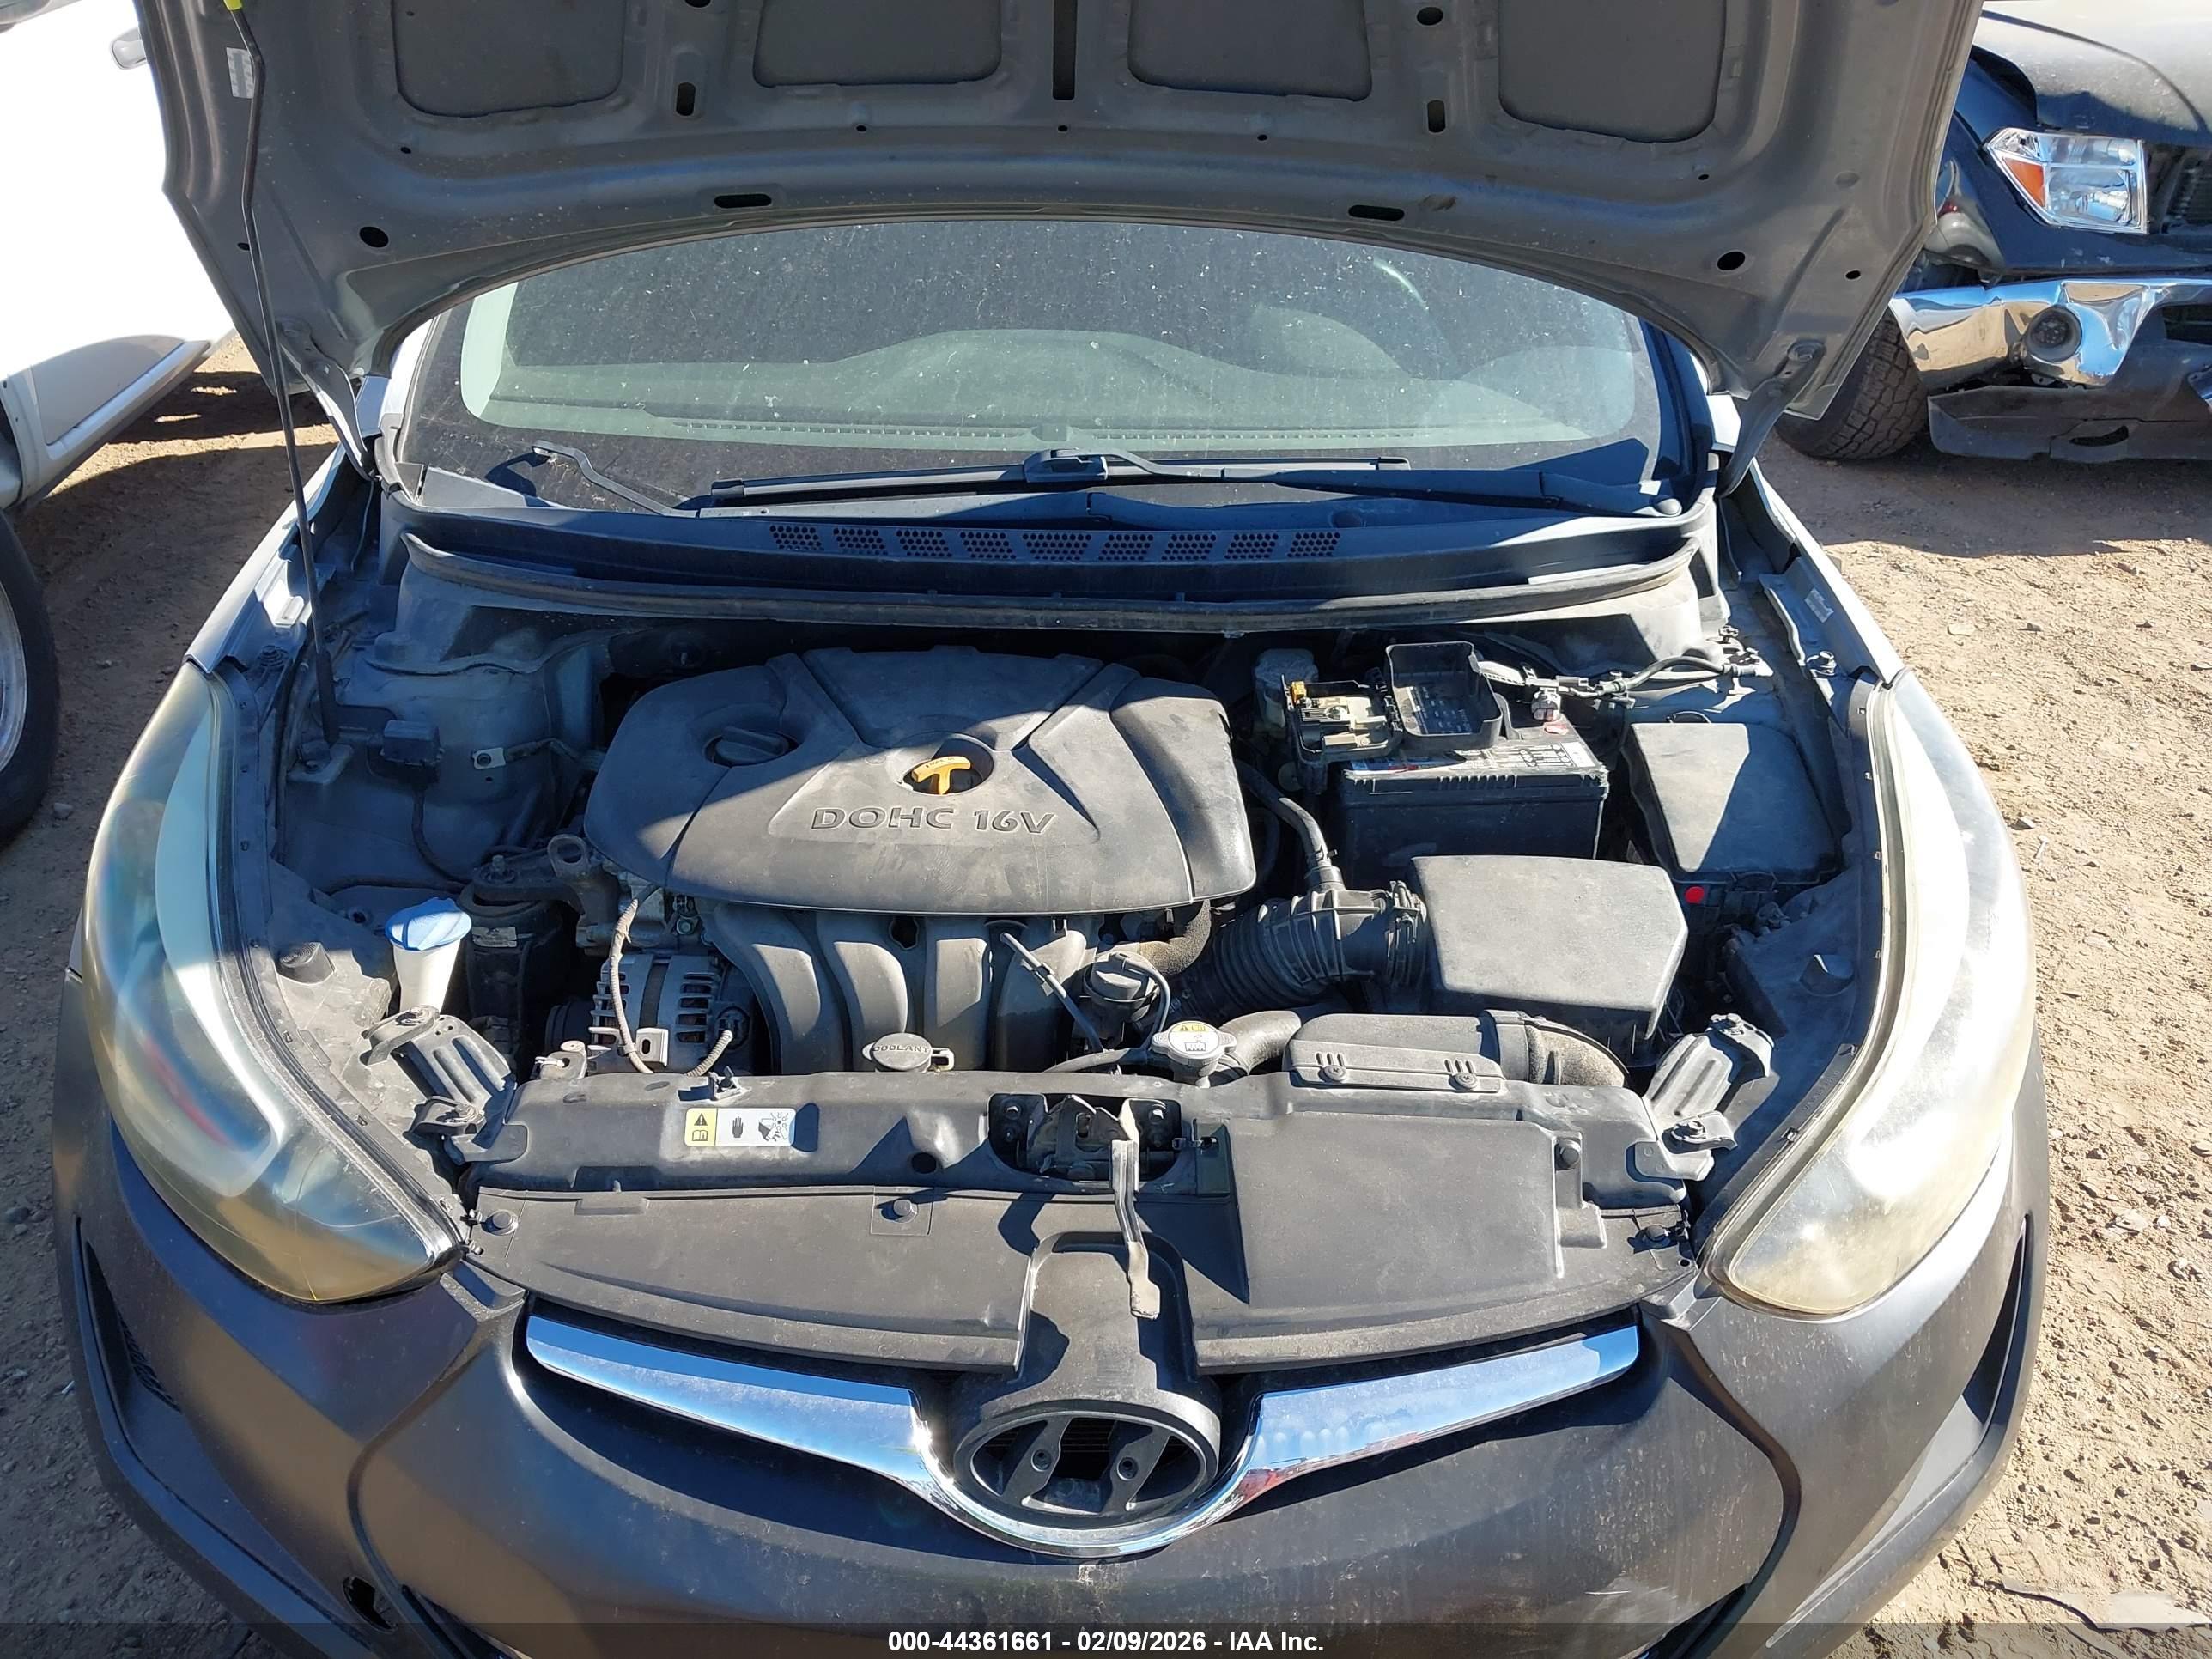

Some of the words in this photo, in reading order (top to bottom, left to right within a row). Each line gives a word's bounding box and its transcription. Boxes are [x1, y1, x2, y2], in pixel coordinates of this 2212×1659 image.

[811, 806, 954, 830] DOHC
[974, 809, 1054, 834] 16V
[872, 1044, 929, 1053] COOLANT
